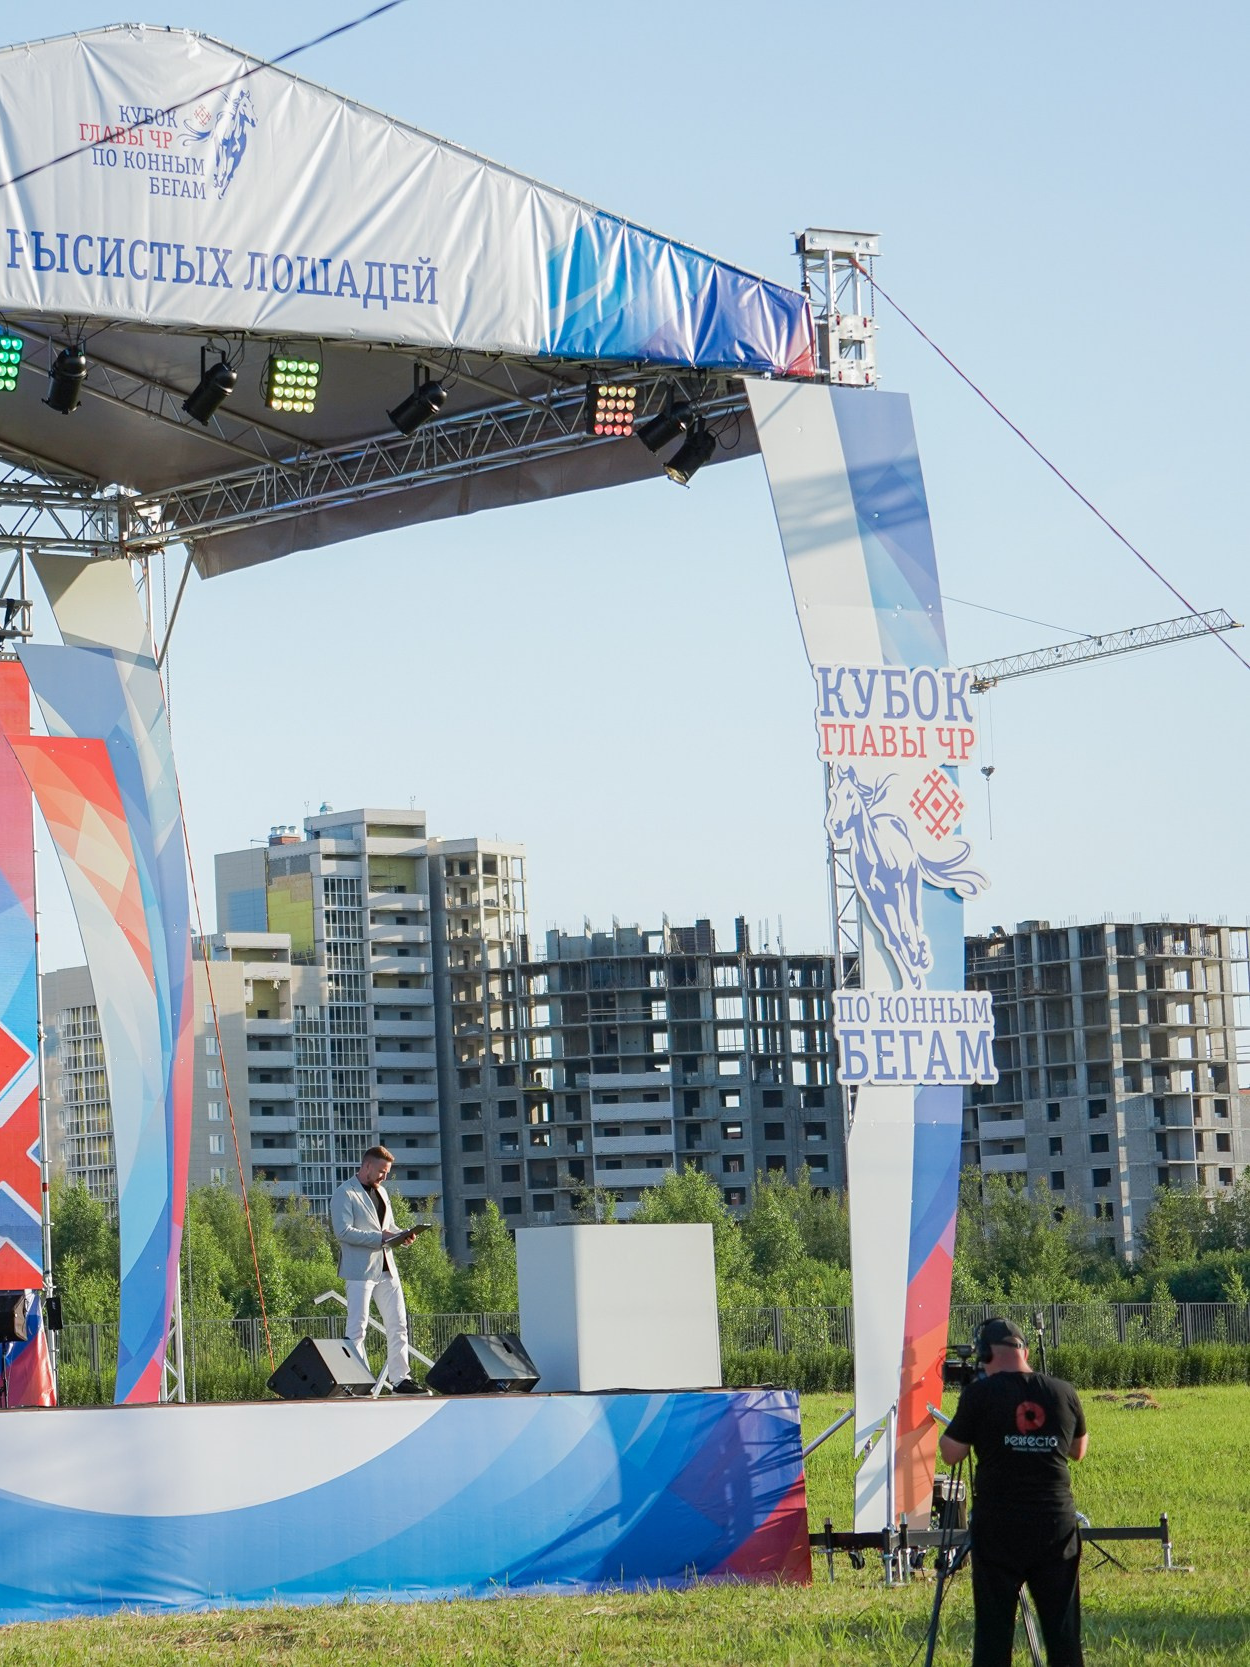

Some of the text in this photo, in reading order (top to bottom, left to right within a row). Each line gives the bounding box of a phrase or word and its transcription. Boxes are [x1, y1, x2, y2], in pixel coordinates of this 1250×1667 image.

[119, 105, 178, 129] КУБОК
[79, 123, 173, 149] ГЛАВЫ ЧР
[91, 147, 206, 176] ПО КОННЫМ
[149, 176, 207, 200] БЕГАМ
[6, 228, 233, 289] РЫСИСТЫХ
[244, 251, 439, 311] ЛОШАДЕЙ
[817, 667, 974, 723] КУБОК
[821, 723, 975, 759] ГЛАВЫ ЧР
[837, 996, 990, 1024] ПО КОННЫМ
[839, 1029, 995, 1081] БЕГАМ
